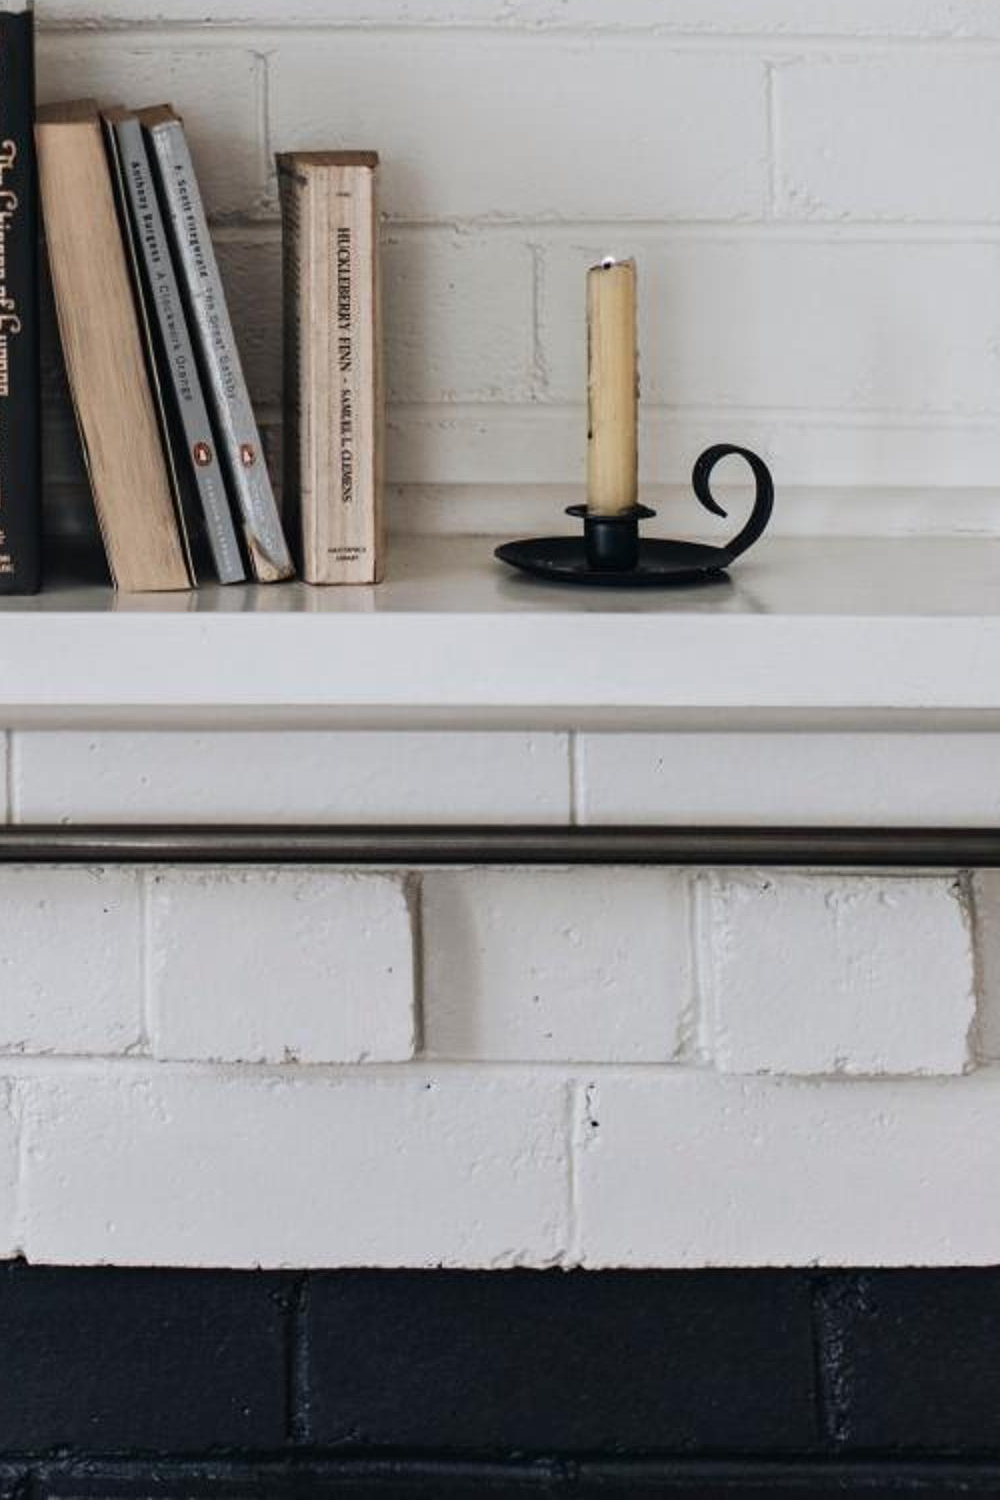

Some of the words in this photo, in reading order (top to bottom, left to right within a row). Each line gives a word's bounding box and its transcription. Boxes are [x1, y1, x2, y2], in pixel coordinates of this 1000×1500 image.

[177, 179, 192, 212] Scott
[336, 226, 351, 330] HUCKLEBERRY
[338, 336, 352, 372] FINN
[340, 389, 352, 434] SAMUEL
[341, 451, 353, 503] CLEMENS
